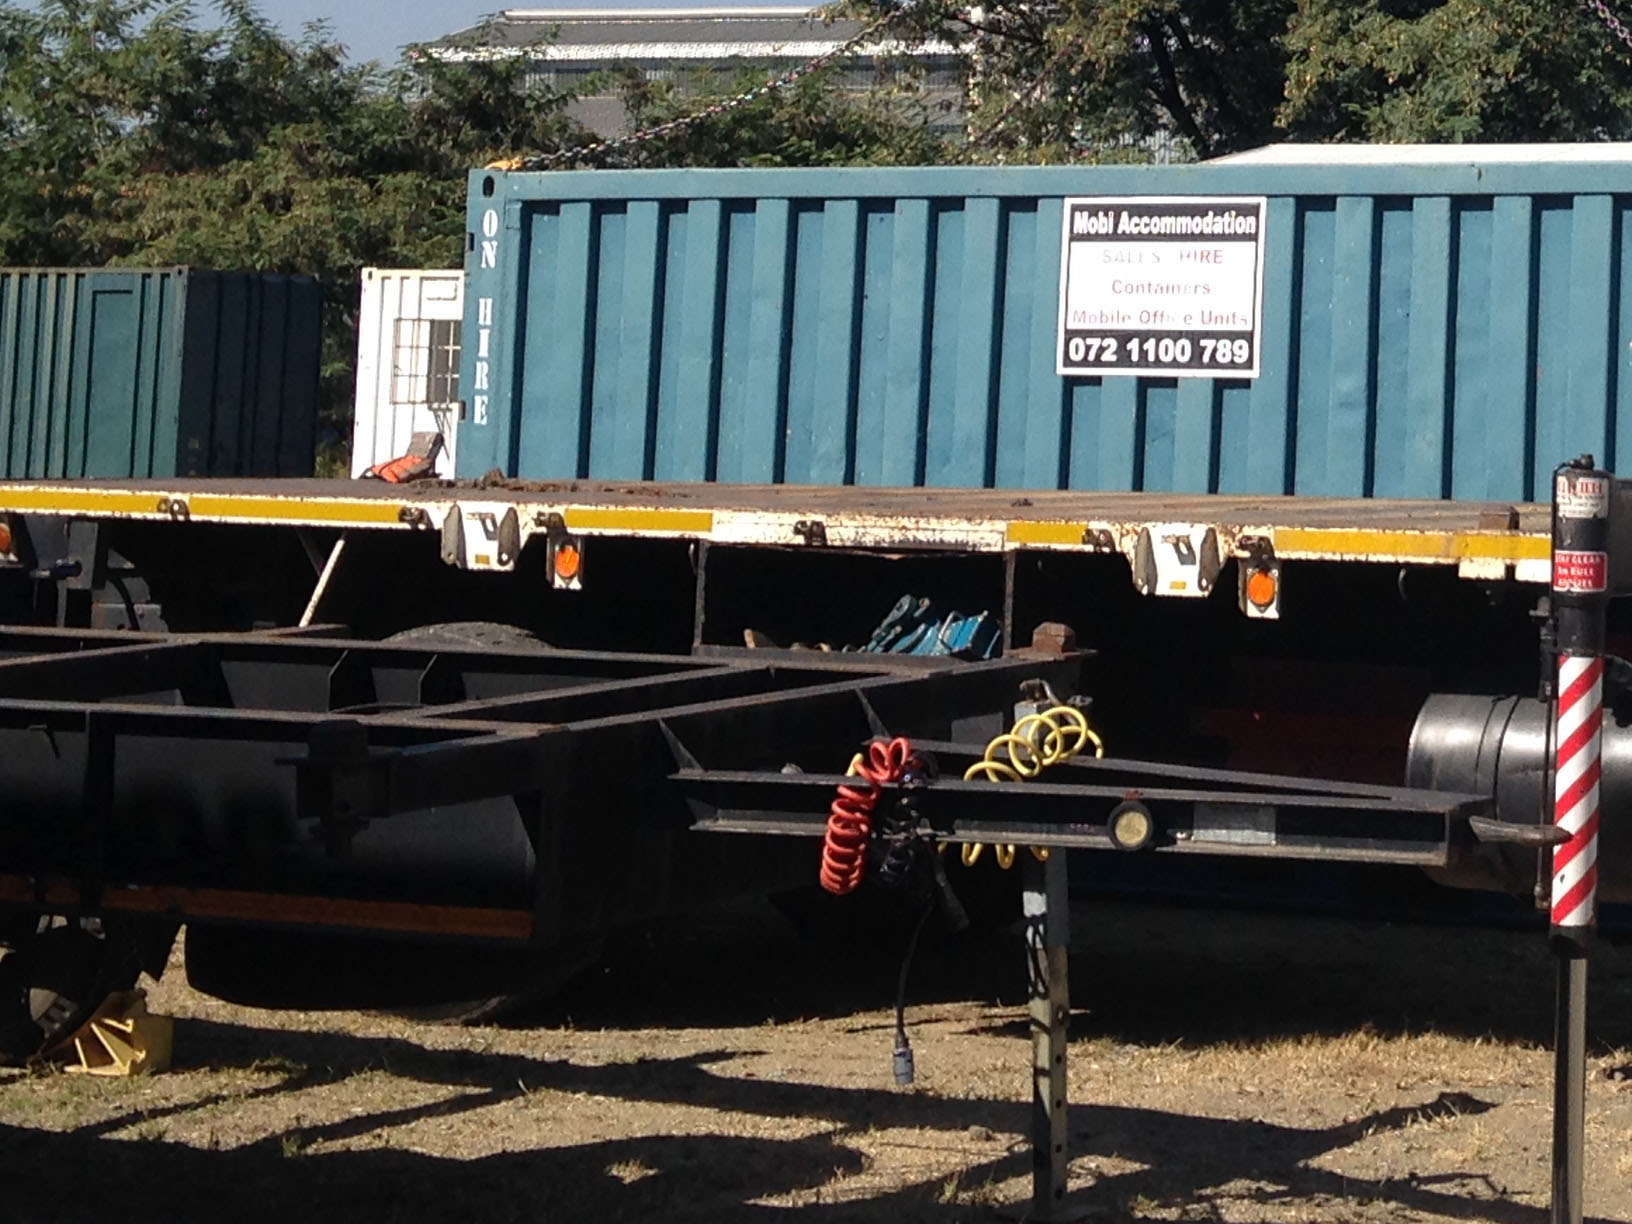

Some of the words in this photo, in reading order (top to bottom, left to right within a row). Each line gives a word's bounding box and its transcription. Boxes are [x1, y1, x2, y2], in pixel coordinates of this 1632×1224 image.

[1073, 211, 1114, 234] Mobi
[1117, 210, 1256, 235] Accommodation
[480, 209, 499, 269] ON
[1111, 280, 1211, 295] Containers
[1139, 310, 1193, 325] Offie
[473, 298, 494, 426] HIRE
[1068, 338, 1118, 362] 072
[1126, 338, 1192, 363] 1100
[1200, 339, 1250, 364] 789
